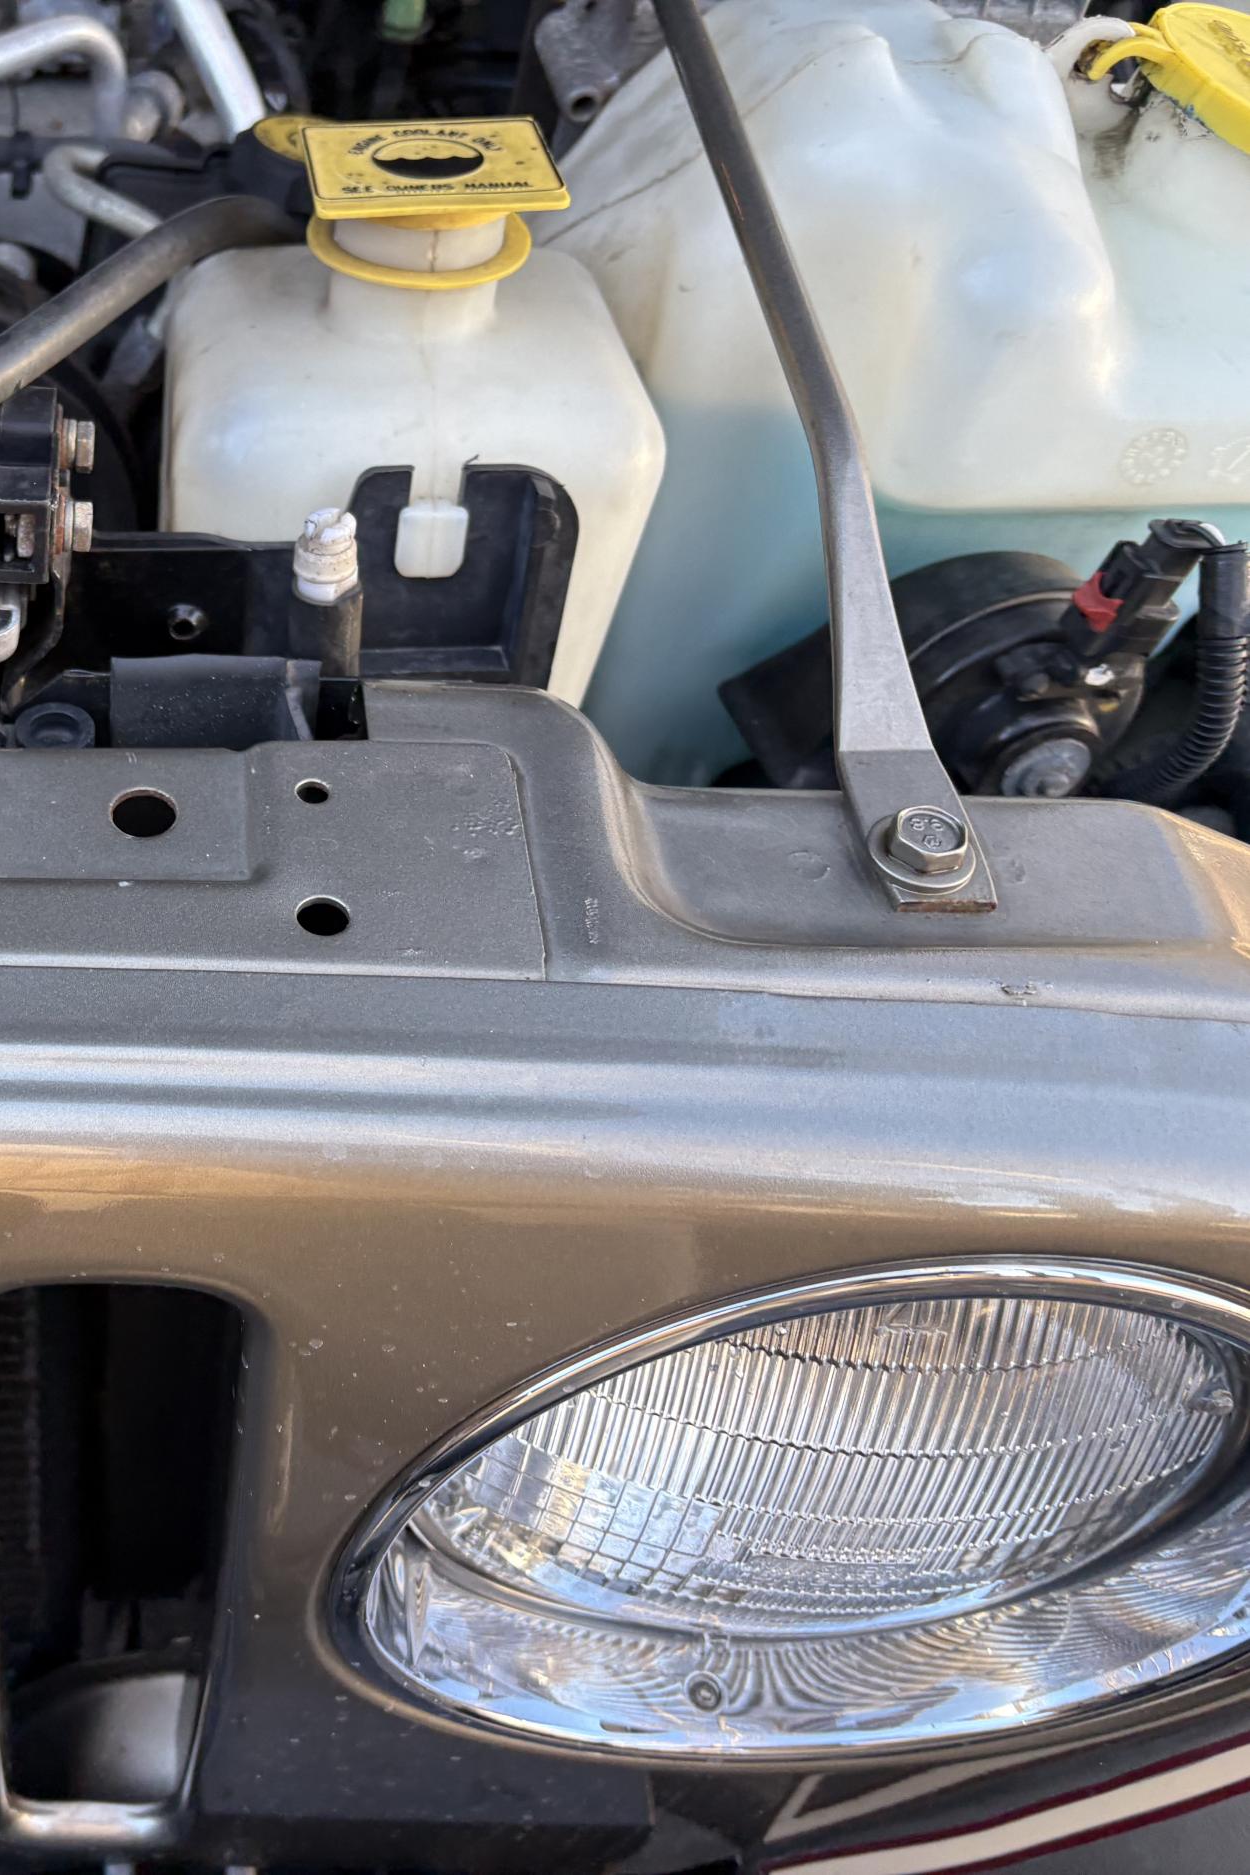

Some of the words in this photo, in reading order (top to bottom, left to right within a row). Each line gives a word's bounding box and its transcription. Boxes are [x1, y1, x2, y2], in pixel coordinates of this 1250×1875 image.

[391, 128, 470, 140] COOLANT
[341, 185, 375, 194] SEE
[463, 180, 534, 190] MANUAL
